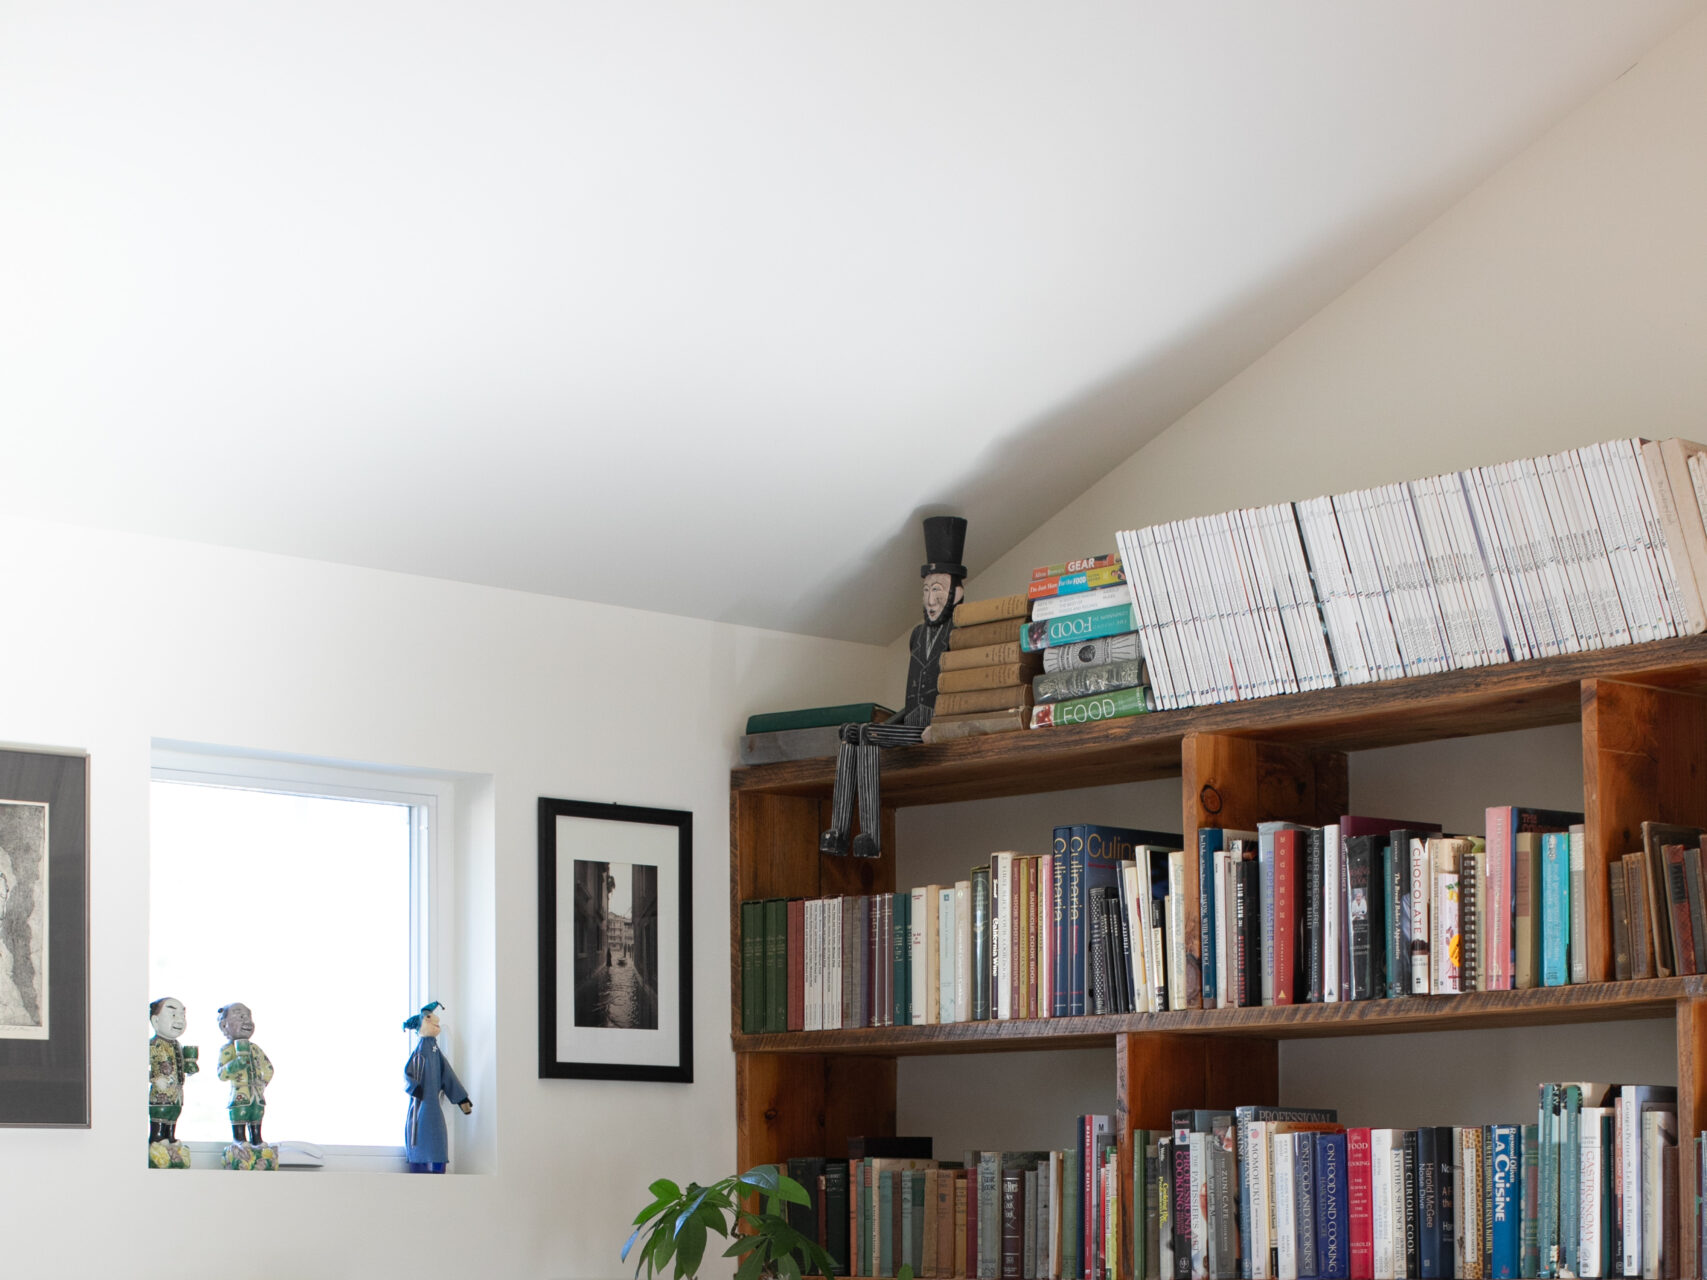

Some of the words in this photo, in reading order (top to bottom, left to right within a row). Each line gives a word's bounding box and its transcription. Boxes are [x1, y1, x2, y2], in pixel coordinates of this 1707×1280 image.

[1068, 558, 1095, 571] GEAR
[1051, 617, 1092, 637] FOOD
[1063, 699, 1115, 724] FOOD
[1054, 838, 1067, 921] Culinaria
[1070, 836, 1083, 920] Culinaria
[1266, 851, 1274, 898] EUROPE'S
[1412, 848, 1422, 934] CHOCOLATE
[1266, 904, 1274, 941] MASTER
[1302, 1141, 1309, 1159] ON
[1327, 1143, 1335, 1161] ON
[1252, 1143, 1260, 1206] MOMOFUKU
[1302, 1159, 1310, 1191] FOOD
[1327, 1163, 1336, 1193] FOOD
[1394, 1153, 1402, 1194] KITCHEN
[1426, 1162, 1434, 1193] Harold
[1303, 1190, 1311, 1217] AND
[1327, 1192, 1336, 1219] AND
[1406, 1172, 1414, 1221] CURIOUS
[1426, 1195, 1434, 1228] McGee
[1585, 1151, 1594, 1243] GASTRONOMY
[1303, 1218, 1312, 1269] COOKING
[1327, 1221, 1337, 1272] COOKING
